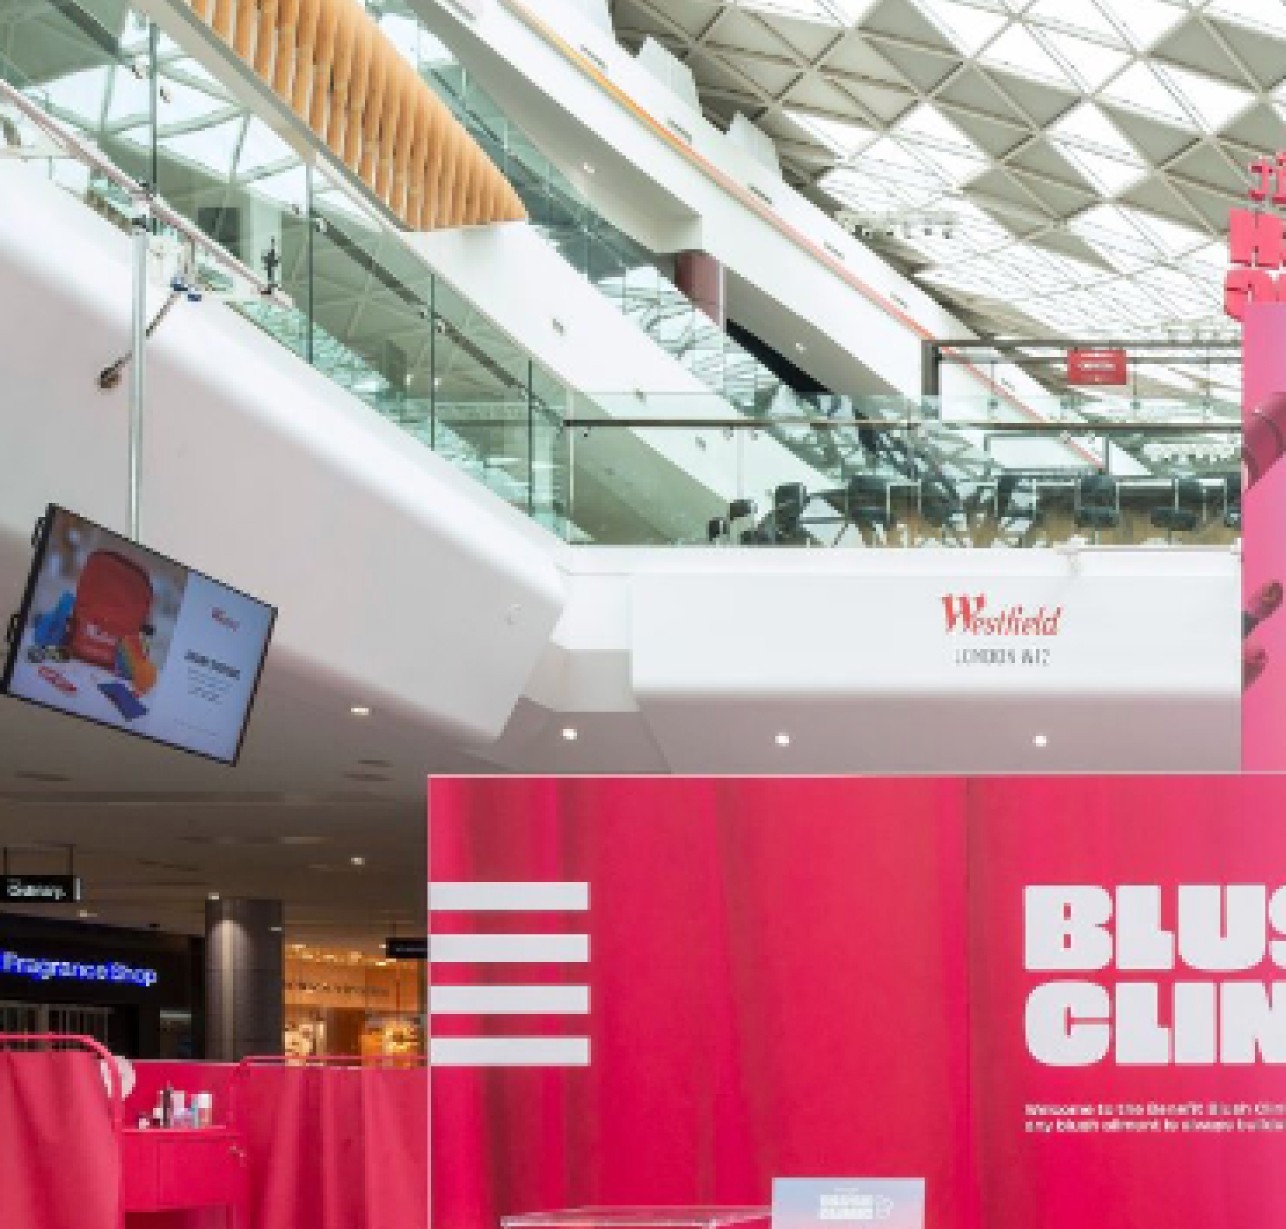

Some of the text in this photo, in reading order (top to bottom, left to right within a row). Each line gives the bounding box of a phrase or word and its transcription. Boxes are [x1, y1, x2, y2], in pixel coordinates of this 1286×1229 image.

[941, 593, 1062, 636] Westfield
[955, 648, 1016, 666] LONDON
[1, 950, 158, 987] Fragrance Shop
